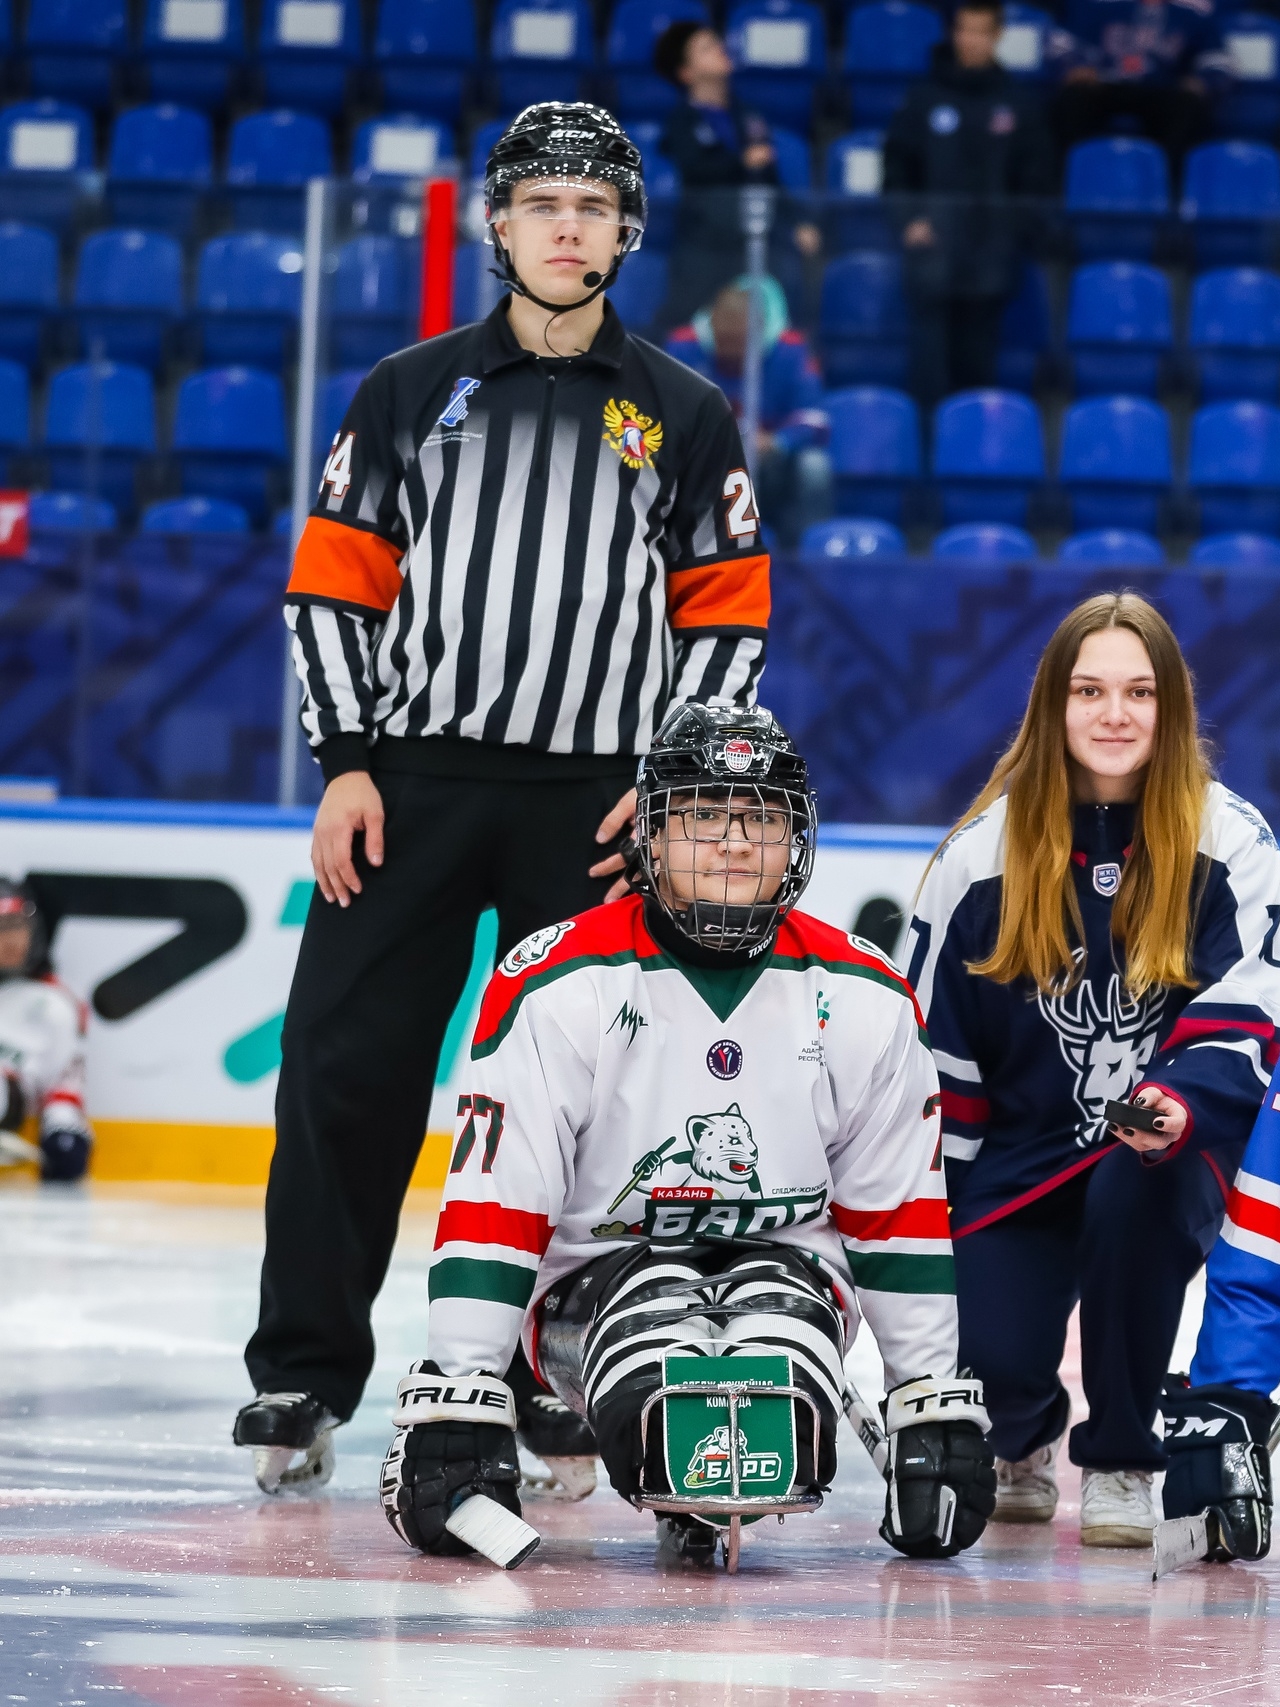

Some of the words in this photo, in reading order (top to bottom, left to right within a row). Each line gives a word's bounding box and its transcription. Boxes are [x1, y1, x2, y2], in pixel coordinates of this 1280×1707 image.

[449, 1093, 505, 1174] 77
[656, 1190, 708, 1199] КАЗАНЬ
[400, 1387, 508, 1410] TRUE
